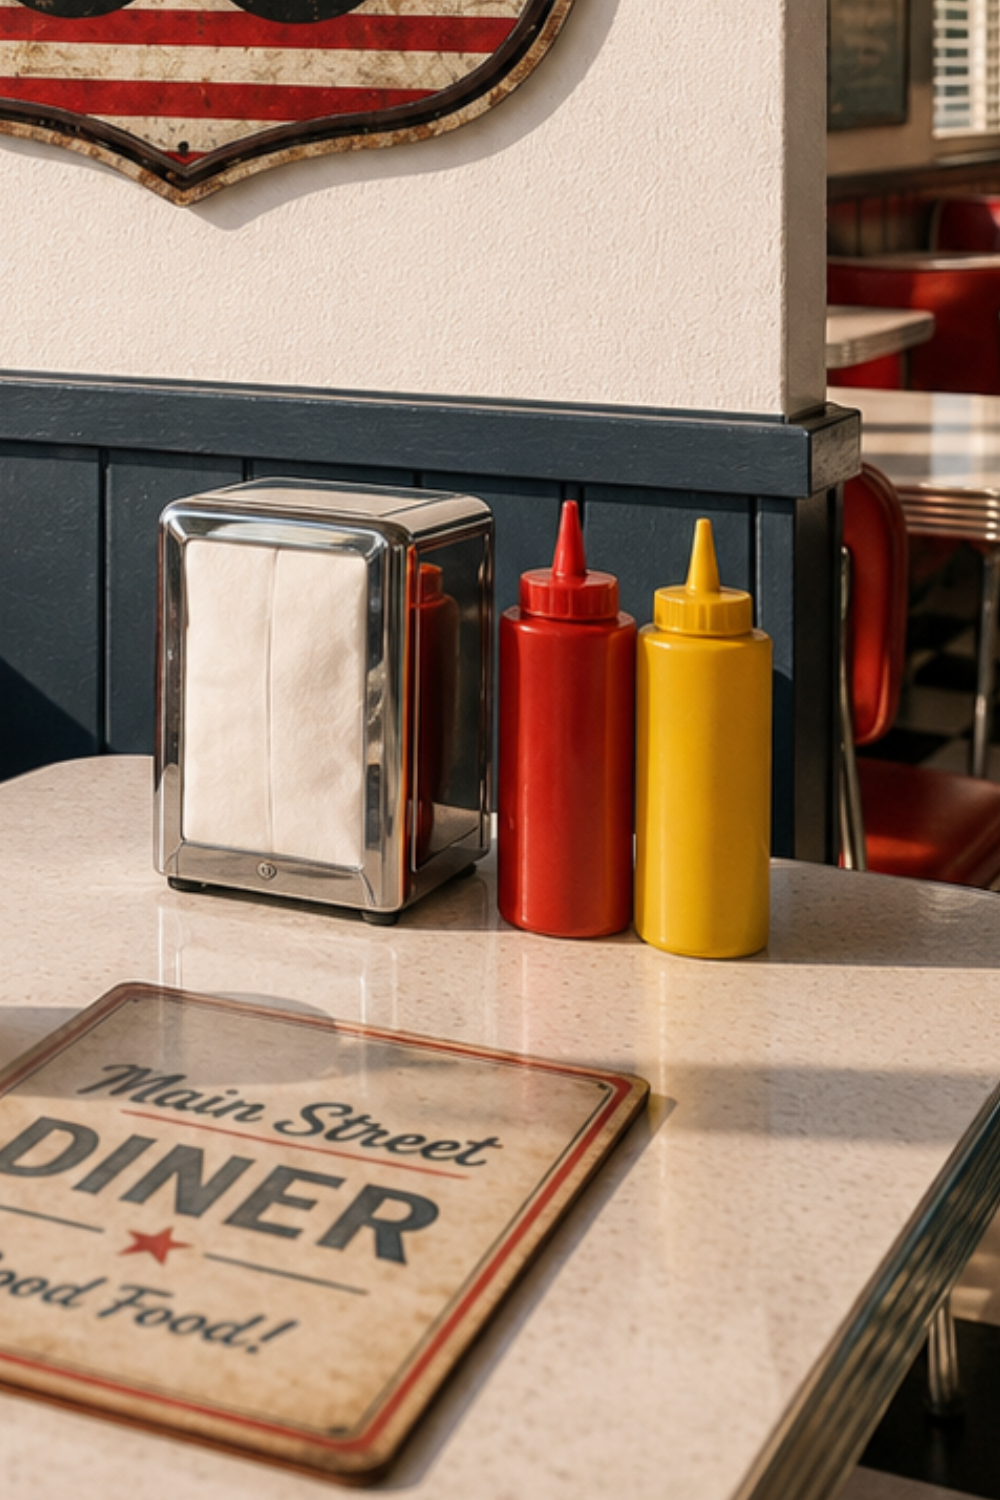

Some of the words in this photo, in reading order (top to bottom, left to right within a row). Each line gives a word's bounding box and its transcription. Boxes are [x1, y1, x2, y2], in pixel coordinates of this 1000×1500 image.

[77, 1063, 262, 1124] Main
[273, 1101, 503, 1167] Street
[98, 1283, 297, 1354] Food!
